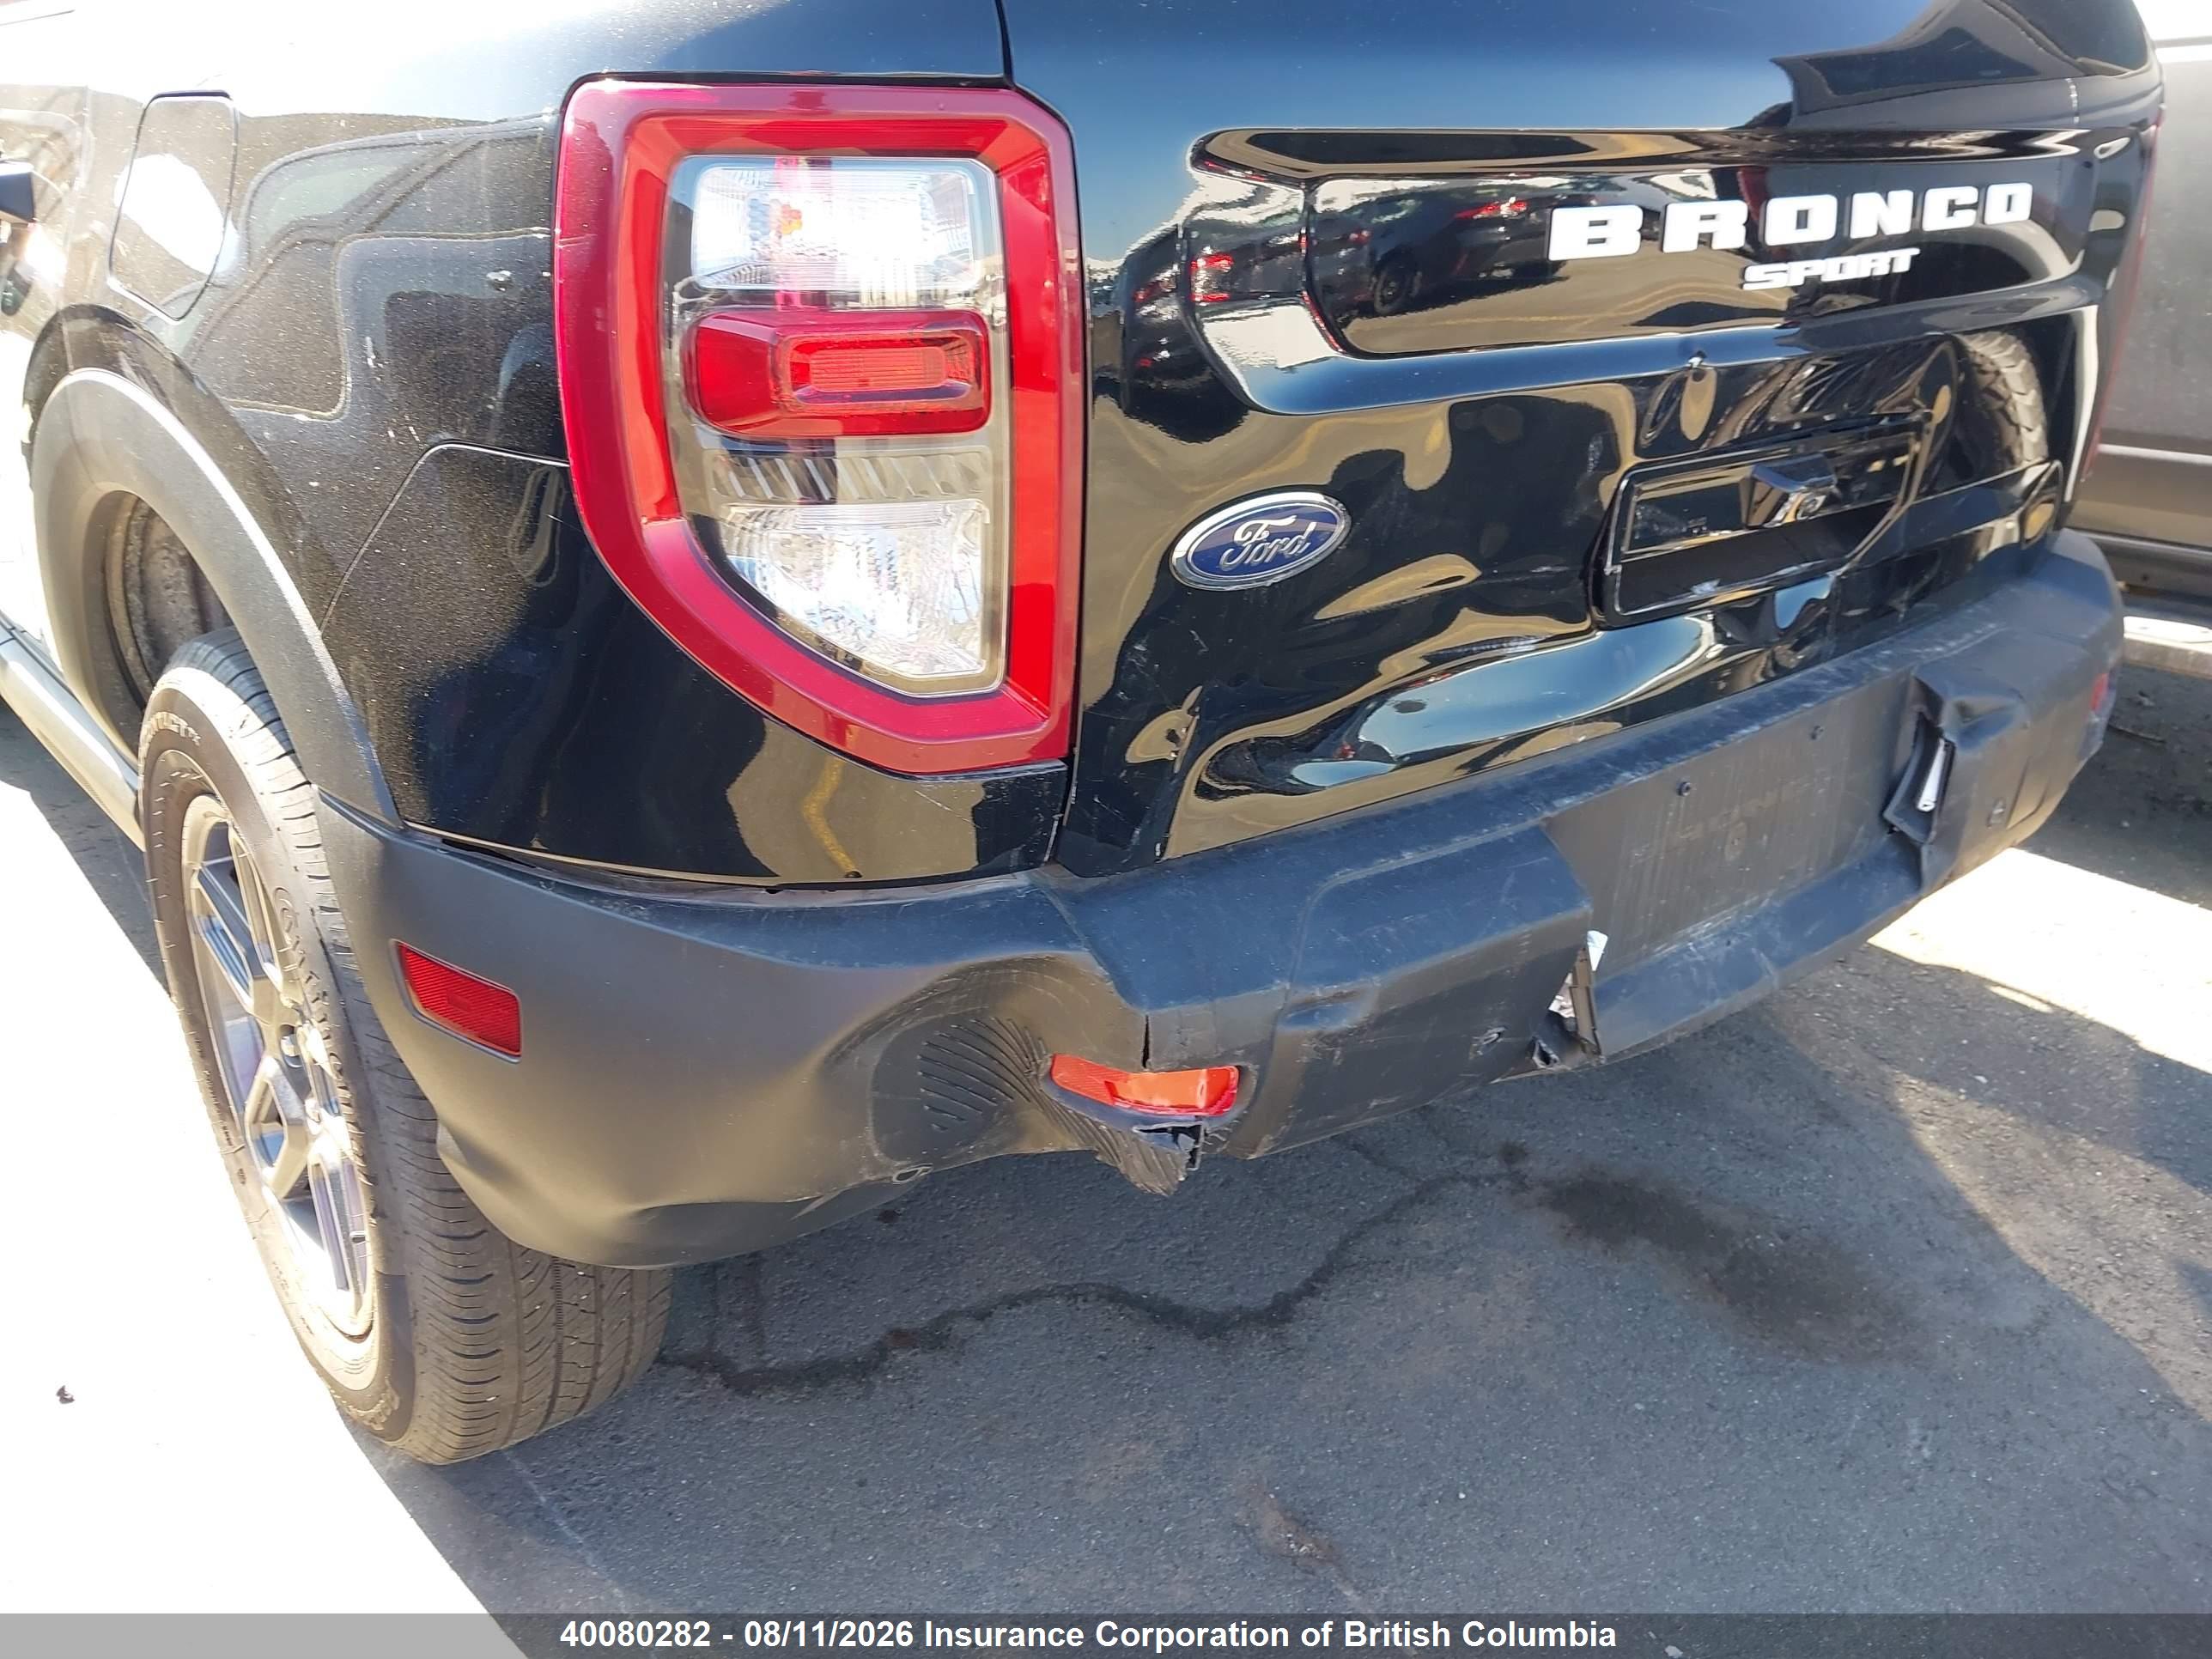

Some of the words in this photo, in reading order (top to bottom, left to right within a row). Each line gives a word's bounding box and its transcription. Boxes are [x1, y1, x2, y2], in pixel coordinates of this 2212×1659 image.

[1548, 182, 2033, 262] BRONCO
[1741, 248, 1921, 292] SPORT
[1218, 515, 1317, 572] Ford
